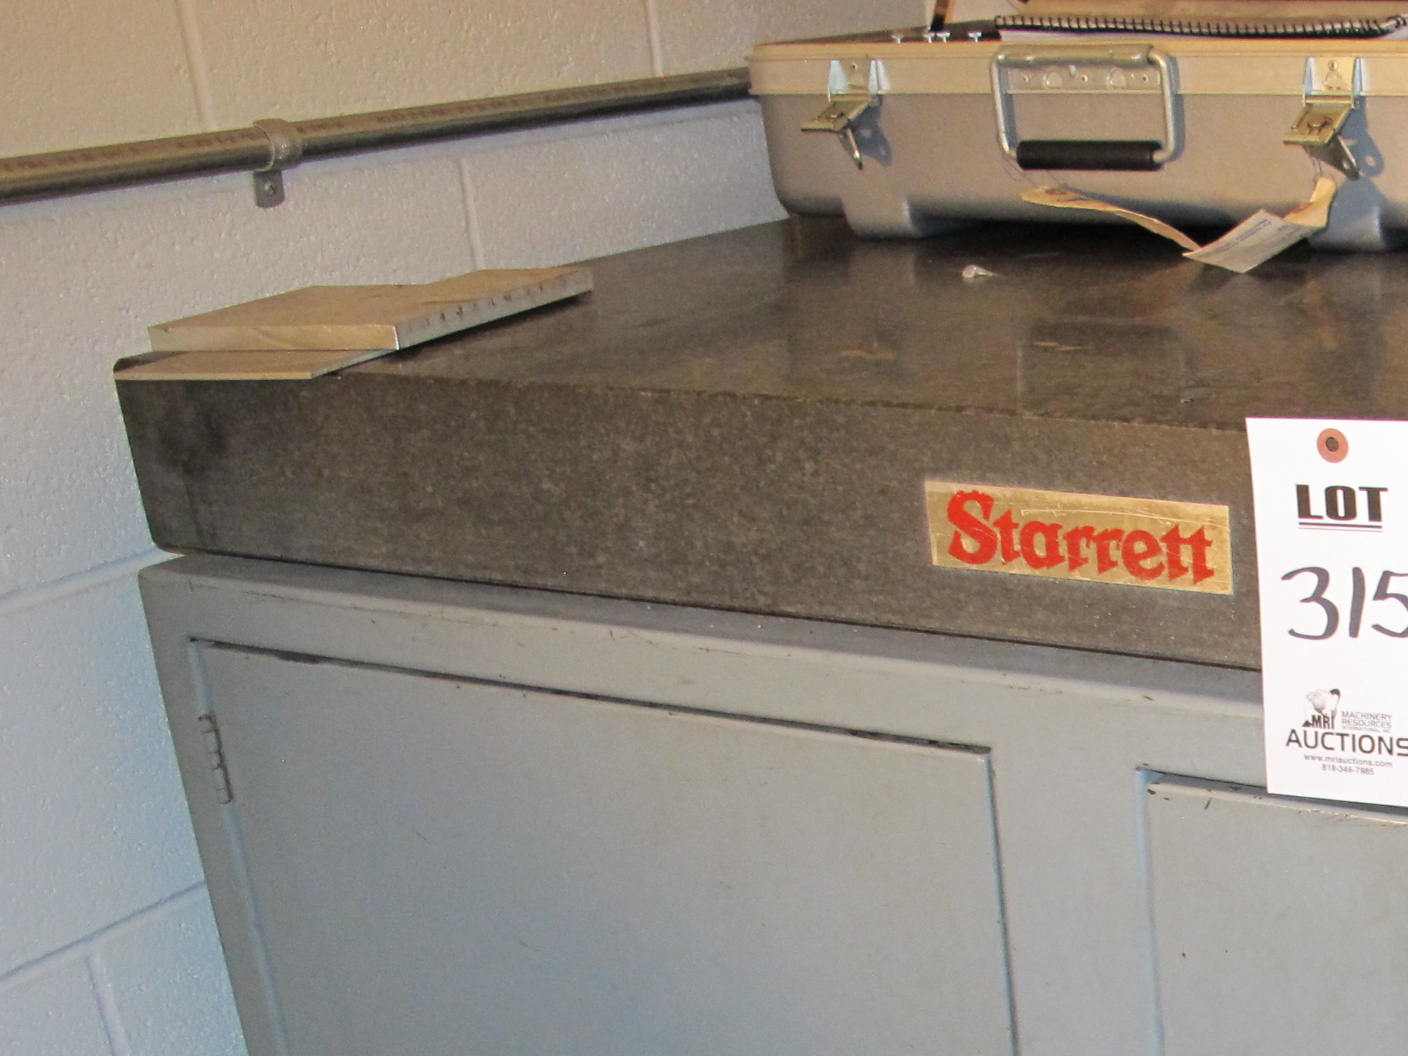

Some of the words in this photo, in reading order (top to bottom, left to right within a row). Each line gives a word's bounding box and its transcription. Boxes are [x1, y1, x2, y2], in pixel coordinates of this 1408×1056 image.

[1295, 484, 1389, 523] LOT
[946, 490, 1215, 584] Starrett
[1341, 711, 1392, 721] MACHINERY
[1341, 719, 1392, 729] RESOURCES
